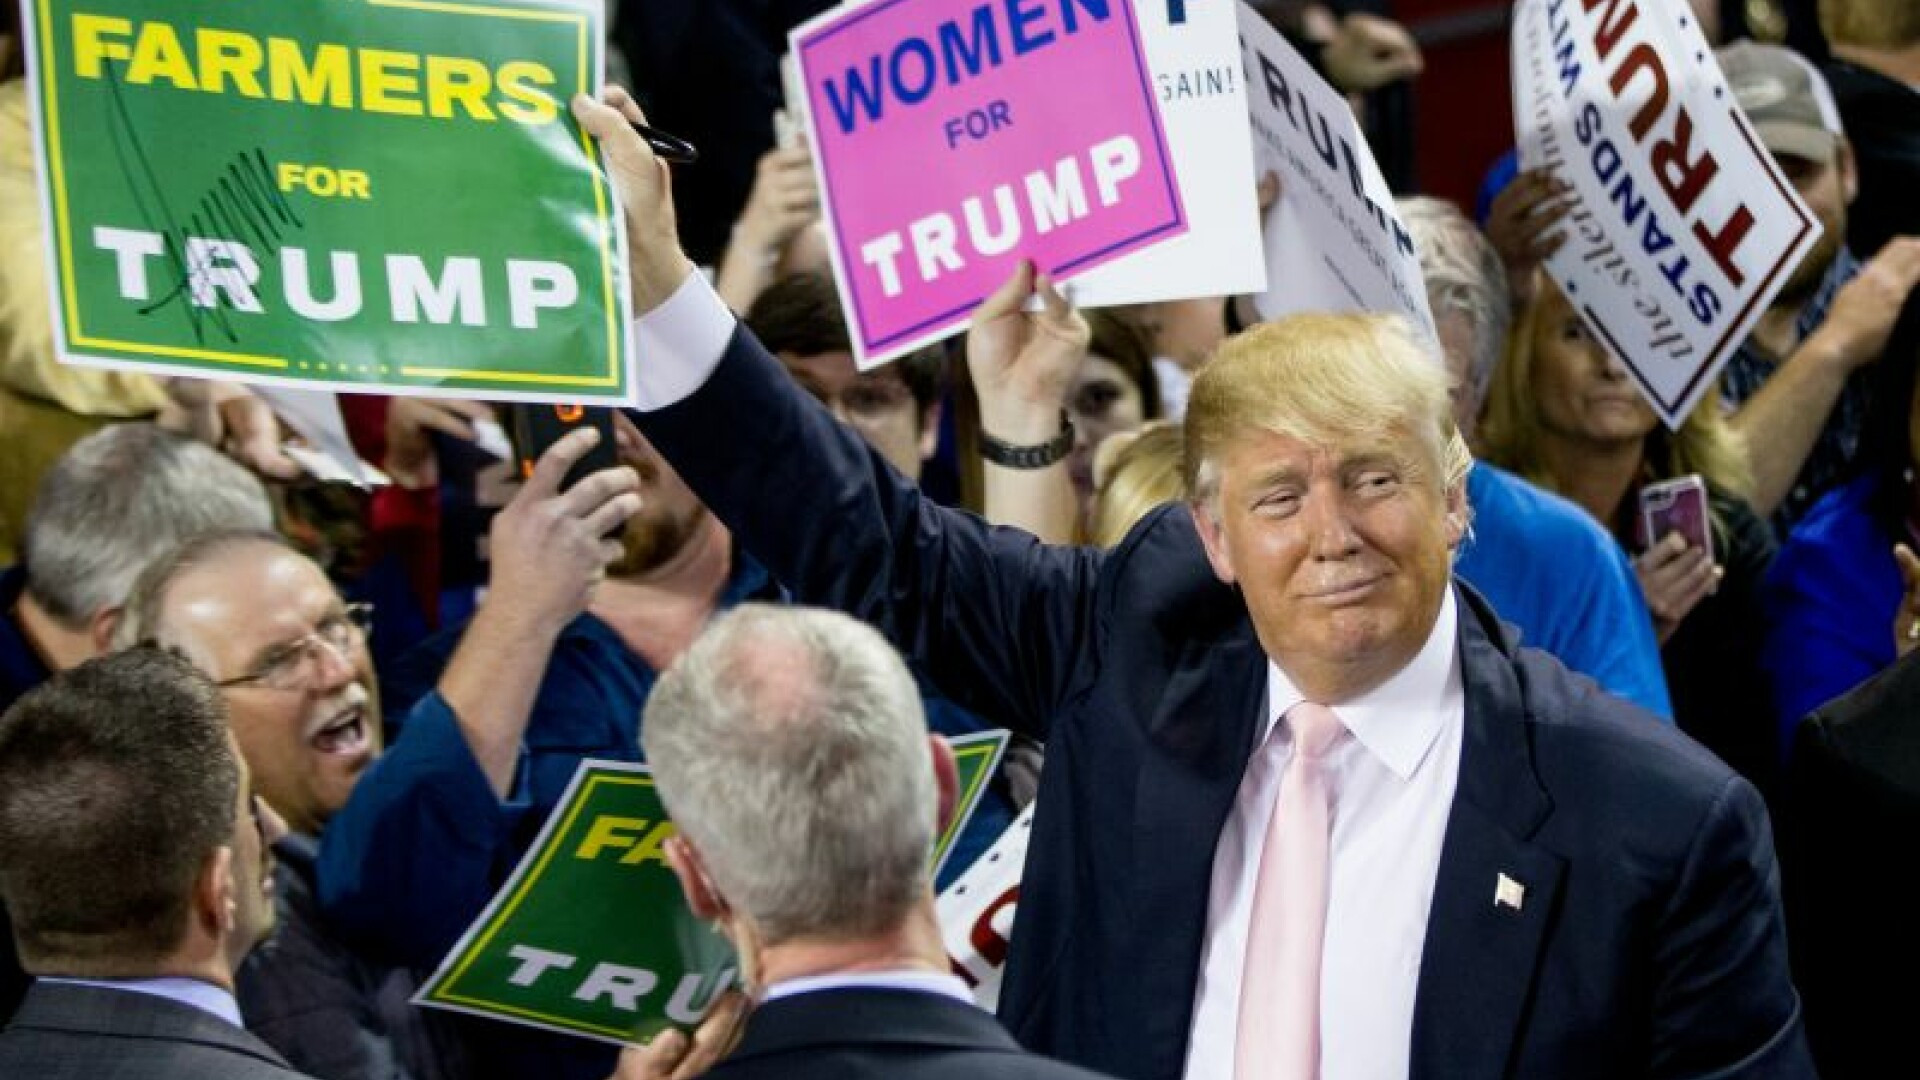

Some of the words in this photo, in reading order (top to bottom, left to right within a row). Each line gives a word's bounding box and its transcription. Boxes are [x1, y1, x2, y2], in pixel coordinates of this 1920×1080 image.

[73, 14, 559, 125] FARMERS
[944, 100, 1013, 149] FOR
[277, 163, 371, 199] FOR
[862, 135, 1141, 298] TRUMP
[1574, 102, 1722, 326] STANDS
[93, 225, 579, 329] TRUMP
[1634, 298, 1694, 359] the
[507, 944, 737, 1025] TRU
